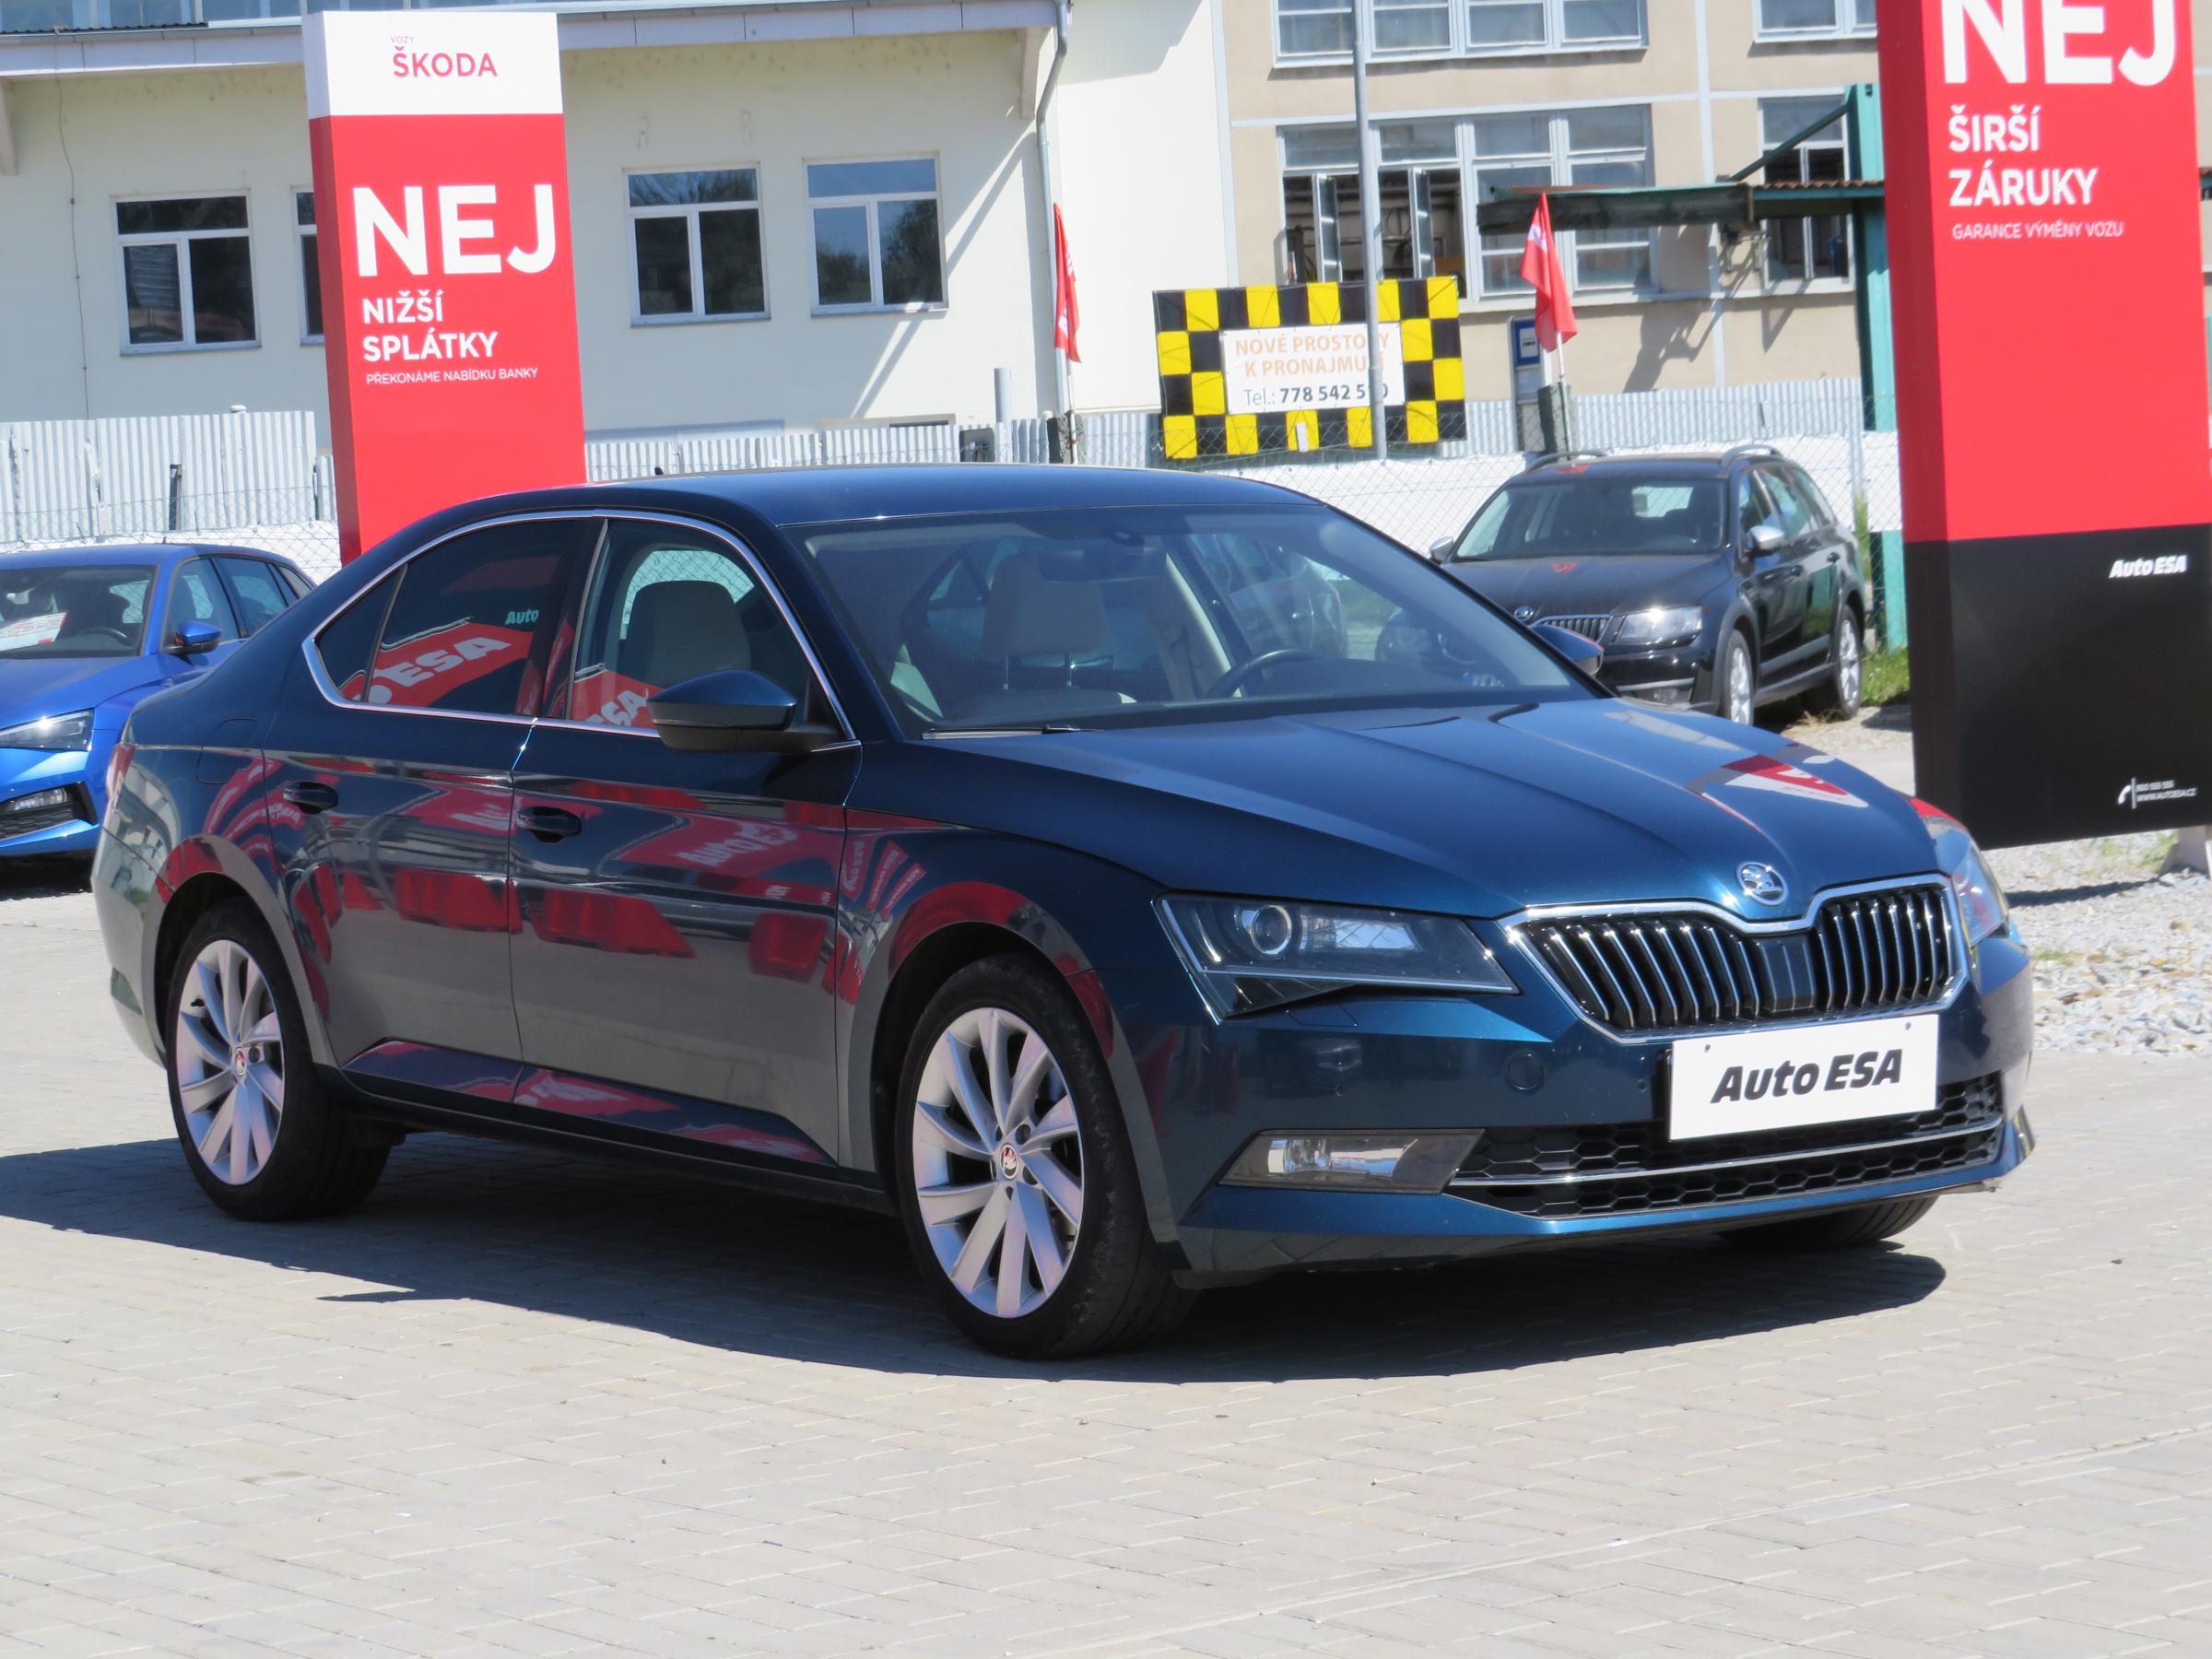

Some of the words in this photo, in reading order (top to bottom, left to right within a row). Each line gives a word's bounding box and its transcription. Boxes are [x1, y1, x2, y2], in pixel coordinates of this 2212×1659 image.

[390, 35, 416, 44] VOZY
[1941, 0, 2176, 87] NEJ
[393, 45, 499, 77] ŠKODA
[1947, 103, 2041, 153] ŠIRŠÍ
[1948, 159, 2099, 207] ZÁRUKY
[352, 183, 557, 277] NEJ
[1951, 222, 2023, 241] GARANCE
[2025, 220, 2084, 239] VÝMĚNY
[2085, 221, 2124, 238] VOZU
[362, 288, 444, 324] NIŽŠÍ
[363, 327, 499, 362] SPLÁTKY
[1235, 334, 1288, 356] NOVÉ
[1292, 332, 1390, 353] PROSTOY
[366, 370, 441, 385] PŘEKONÁME
[443, 367, 497, 383] NABÍDKU
[499, 367, 539, 381] BANKY
[1244, 360, 1258, 378] K
[1243, 386, 1277, 406] Tel.:
[1279, 386, 1313, 404] 778
[1317, 383, 1350, 402] 542
[2109, 558, 2154, 579] Auto
[2153, 554, 2188, 575] ESA
[504, 609, 539, 625] Auto
[1710, 1060, 1820, 1104] Auto
[1823, 1048, 1903, 1092] ESA
